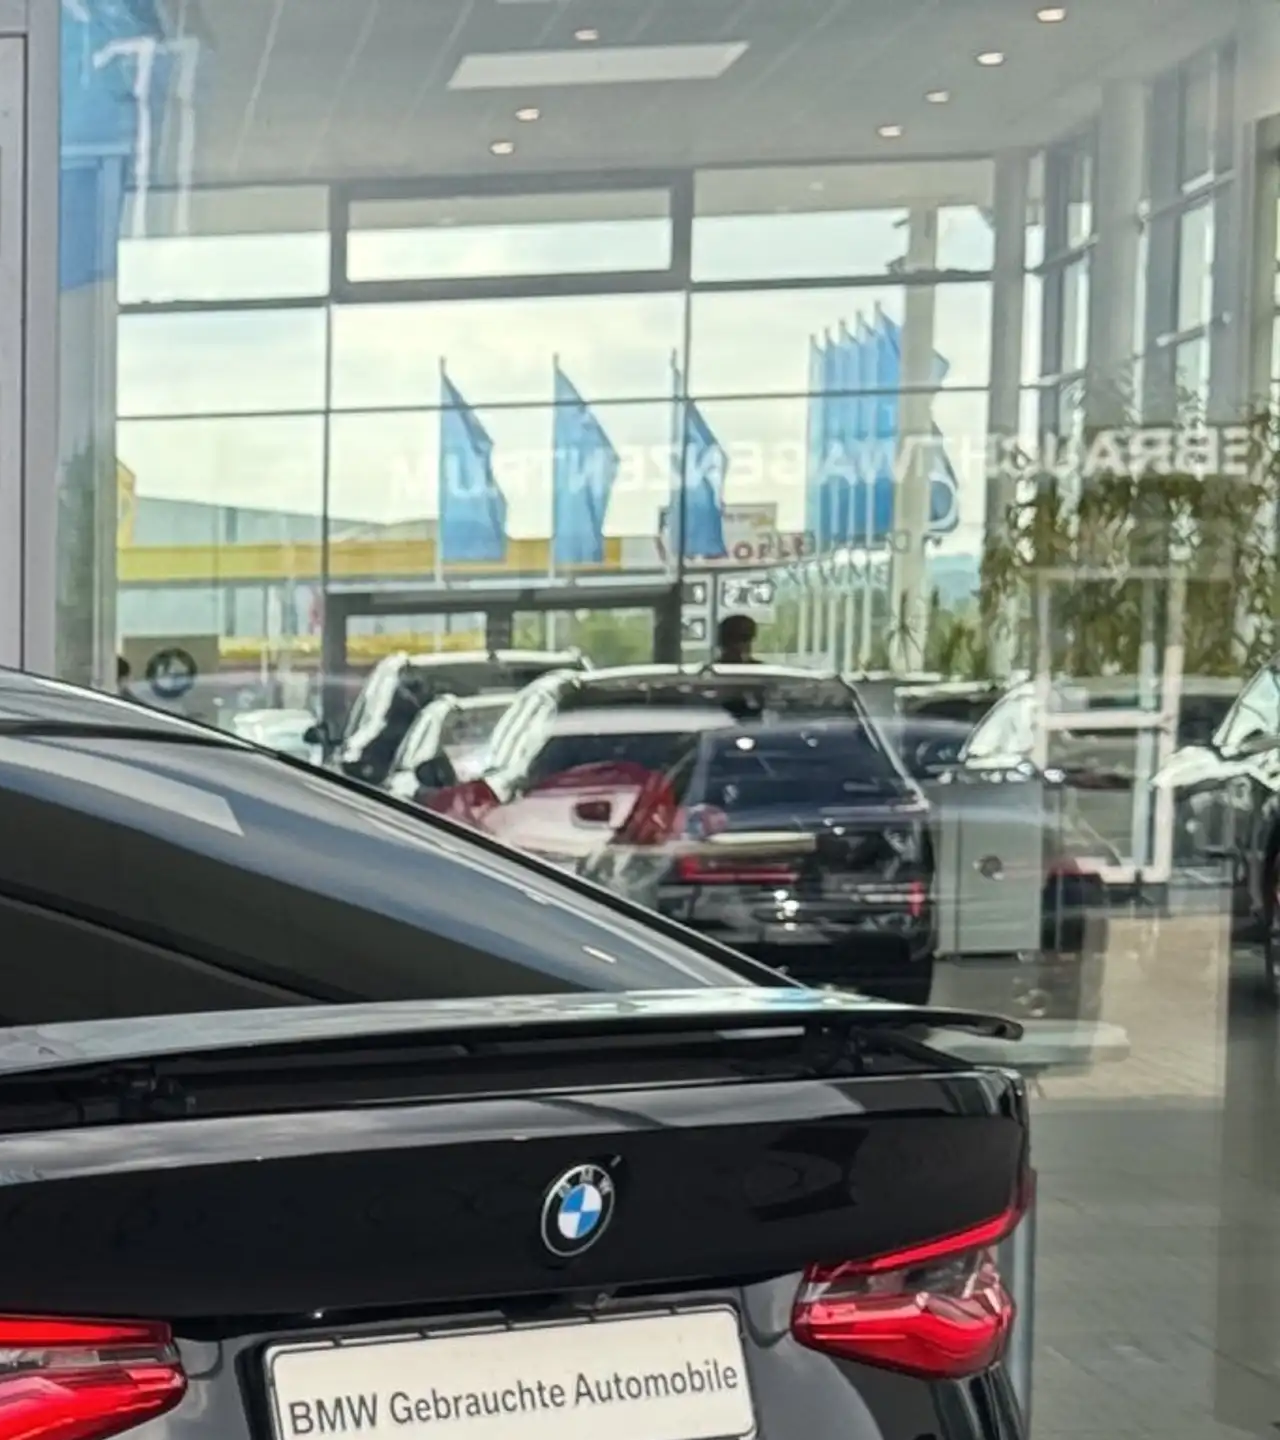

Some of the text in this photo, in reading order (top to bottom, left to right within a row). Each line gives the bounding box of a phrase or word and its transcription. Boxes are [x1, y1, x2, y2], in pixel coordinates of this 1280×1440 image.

[290, 1358, 738, 1435] BMW Gebrauchte Automobile
